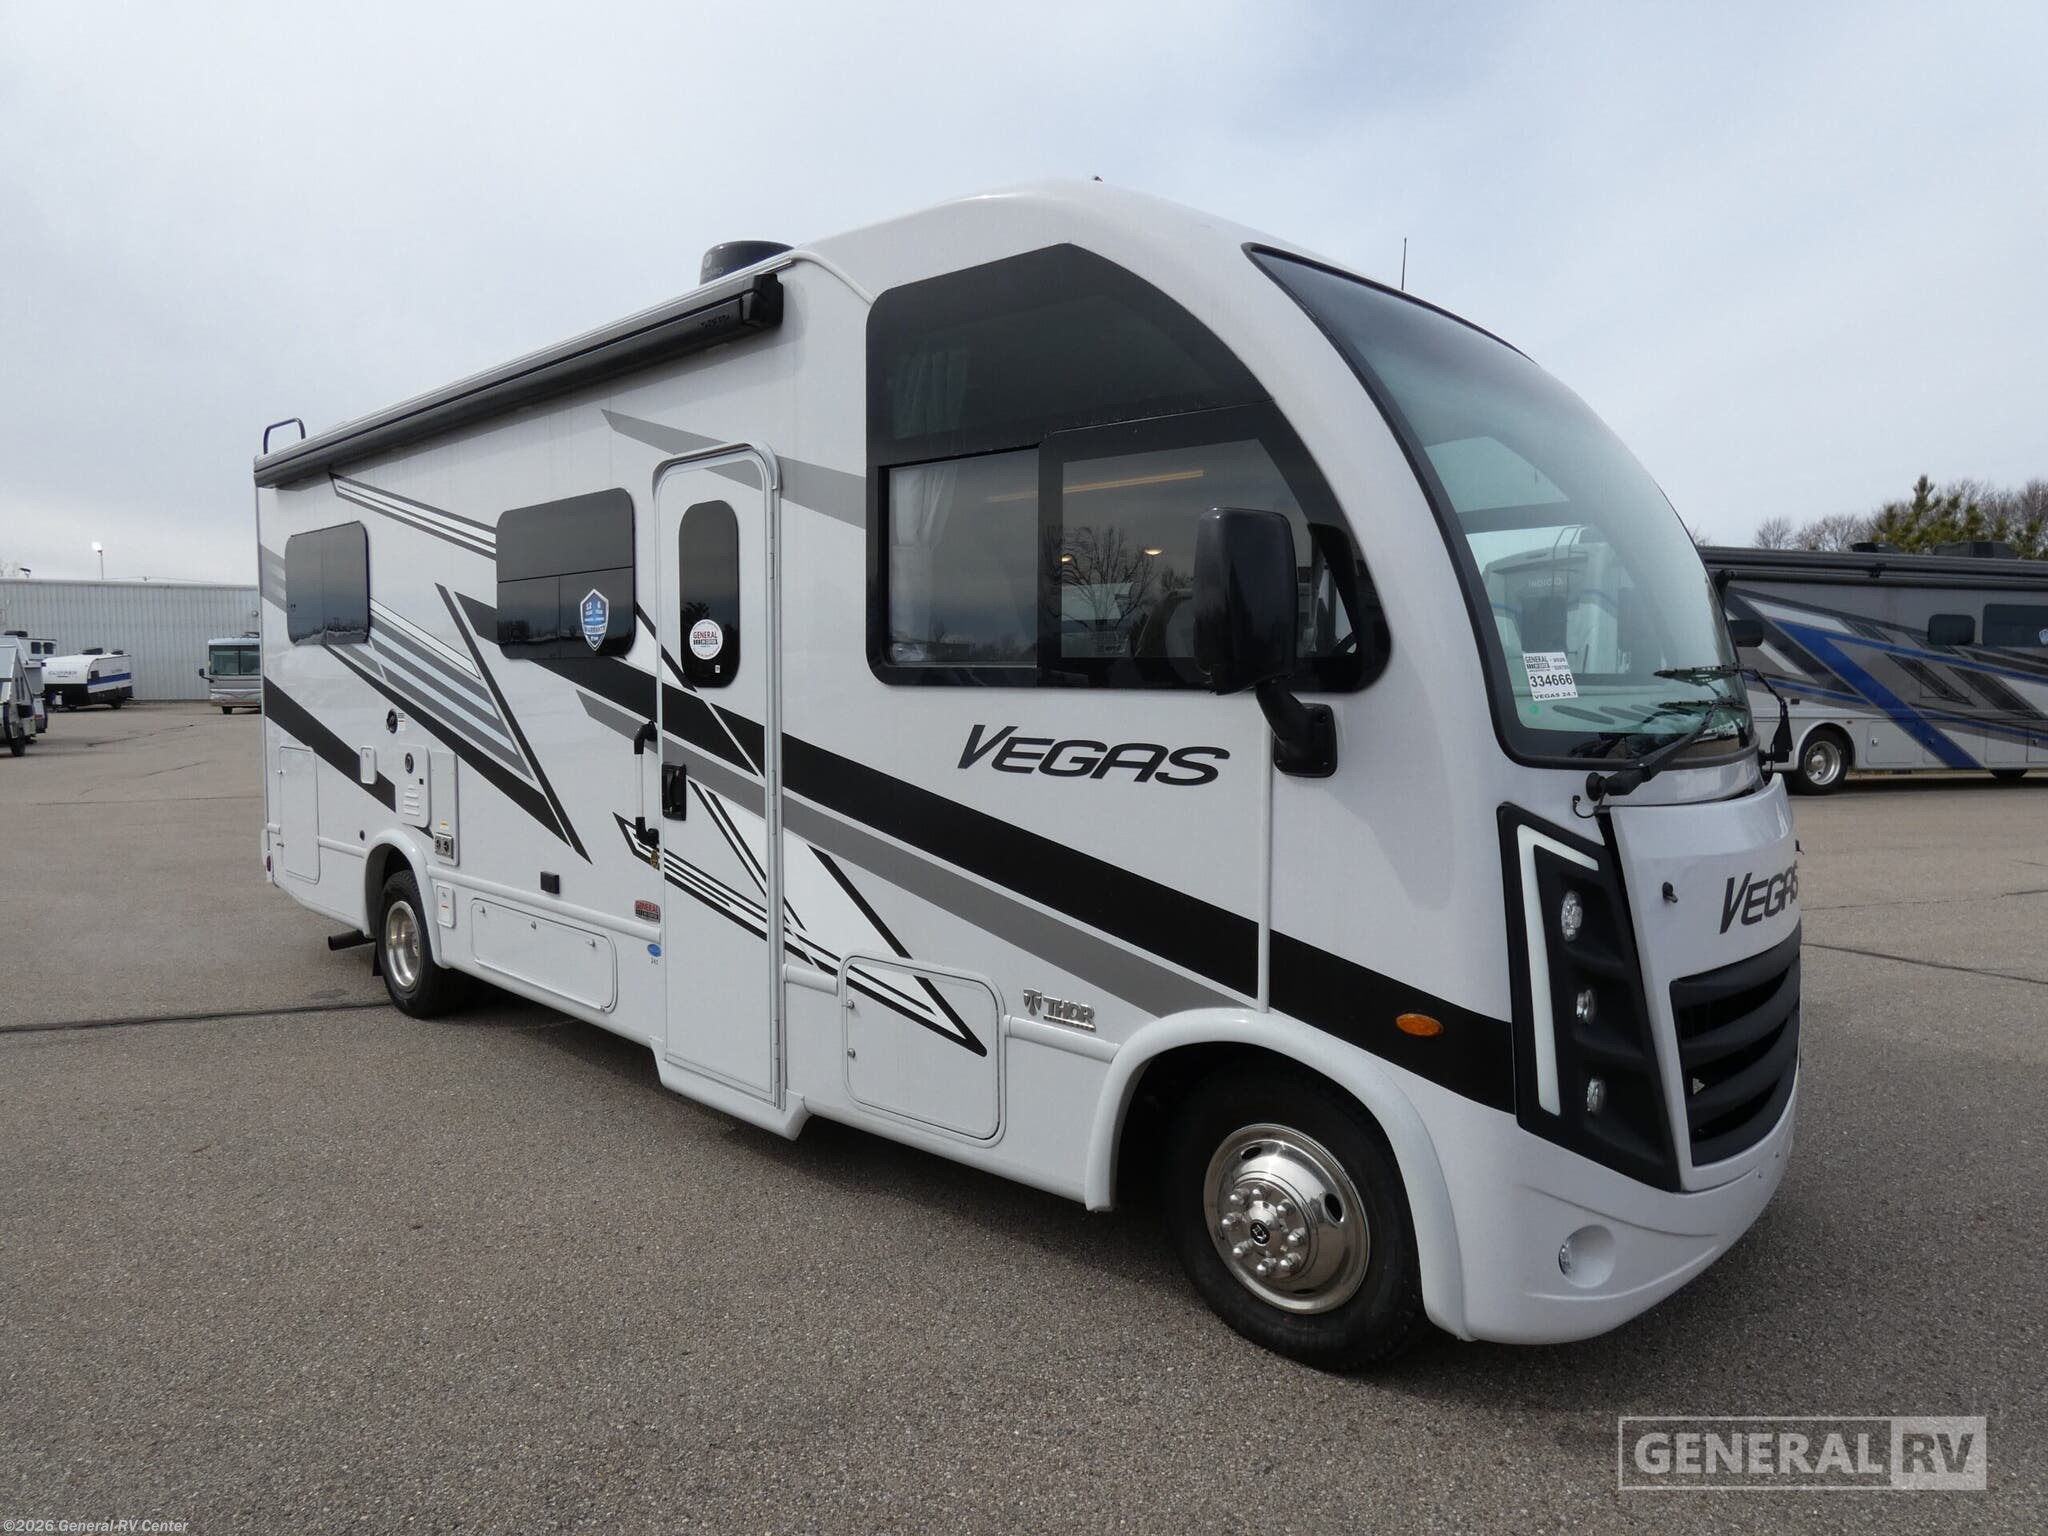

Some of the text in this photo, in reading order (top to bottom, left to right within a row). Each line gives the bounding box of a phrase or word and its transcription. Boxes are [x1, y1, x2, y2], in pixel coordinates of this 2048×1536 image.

[1530, 674, 1572, 688] 334666
[957, 724, 1231, 786] VEGAS
[1719, 864, 1799, 935] VEGAS
[1043, 996, 1096, 1026] THOR
